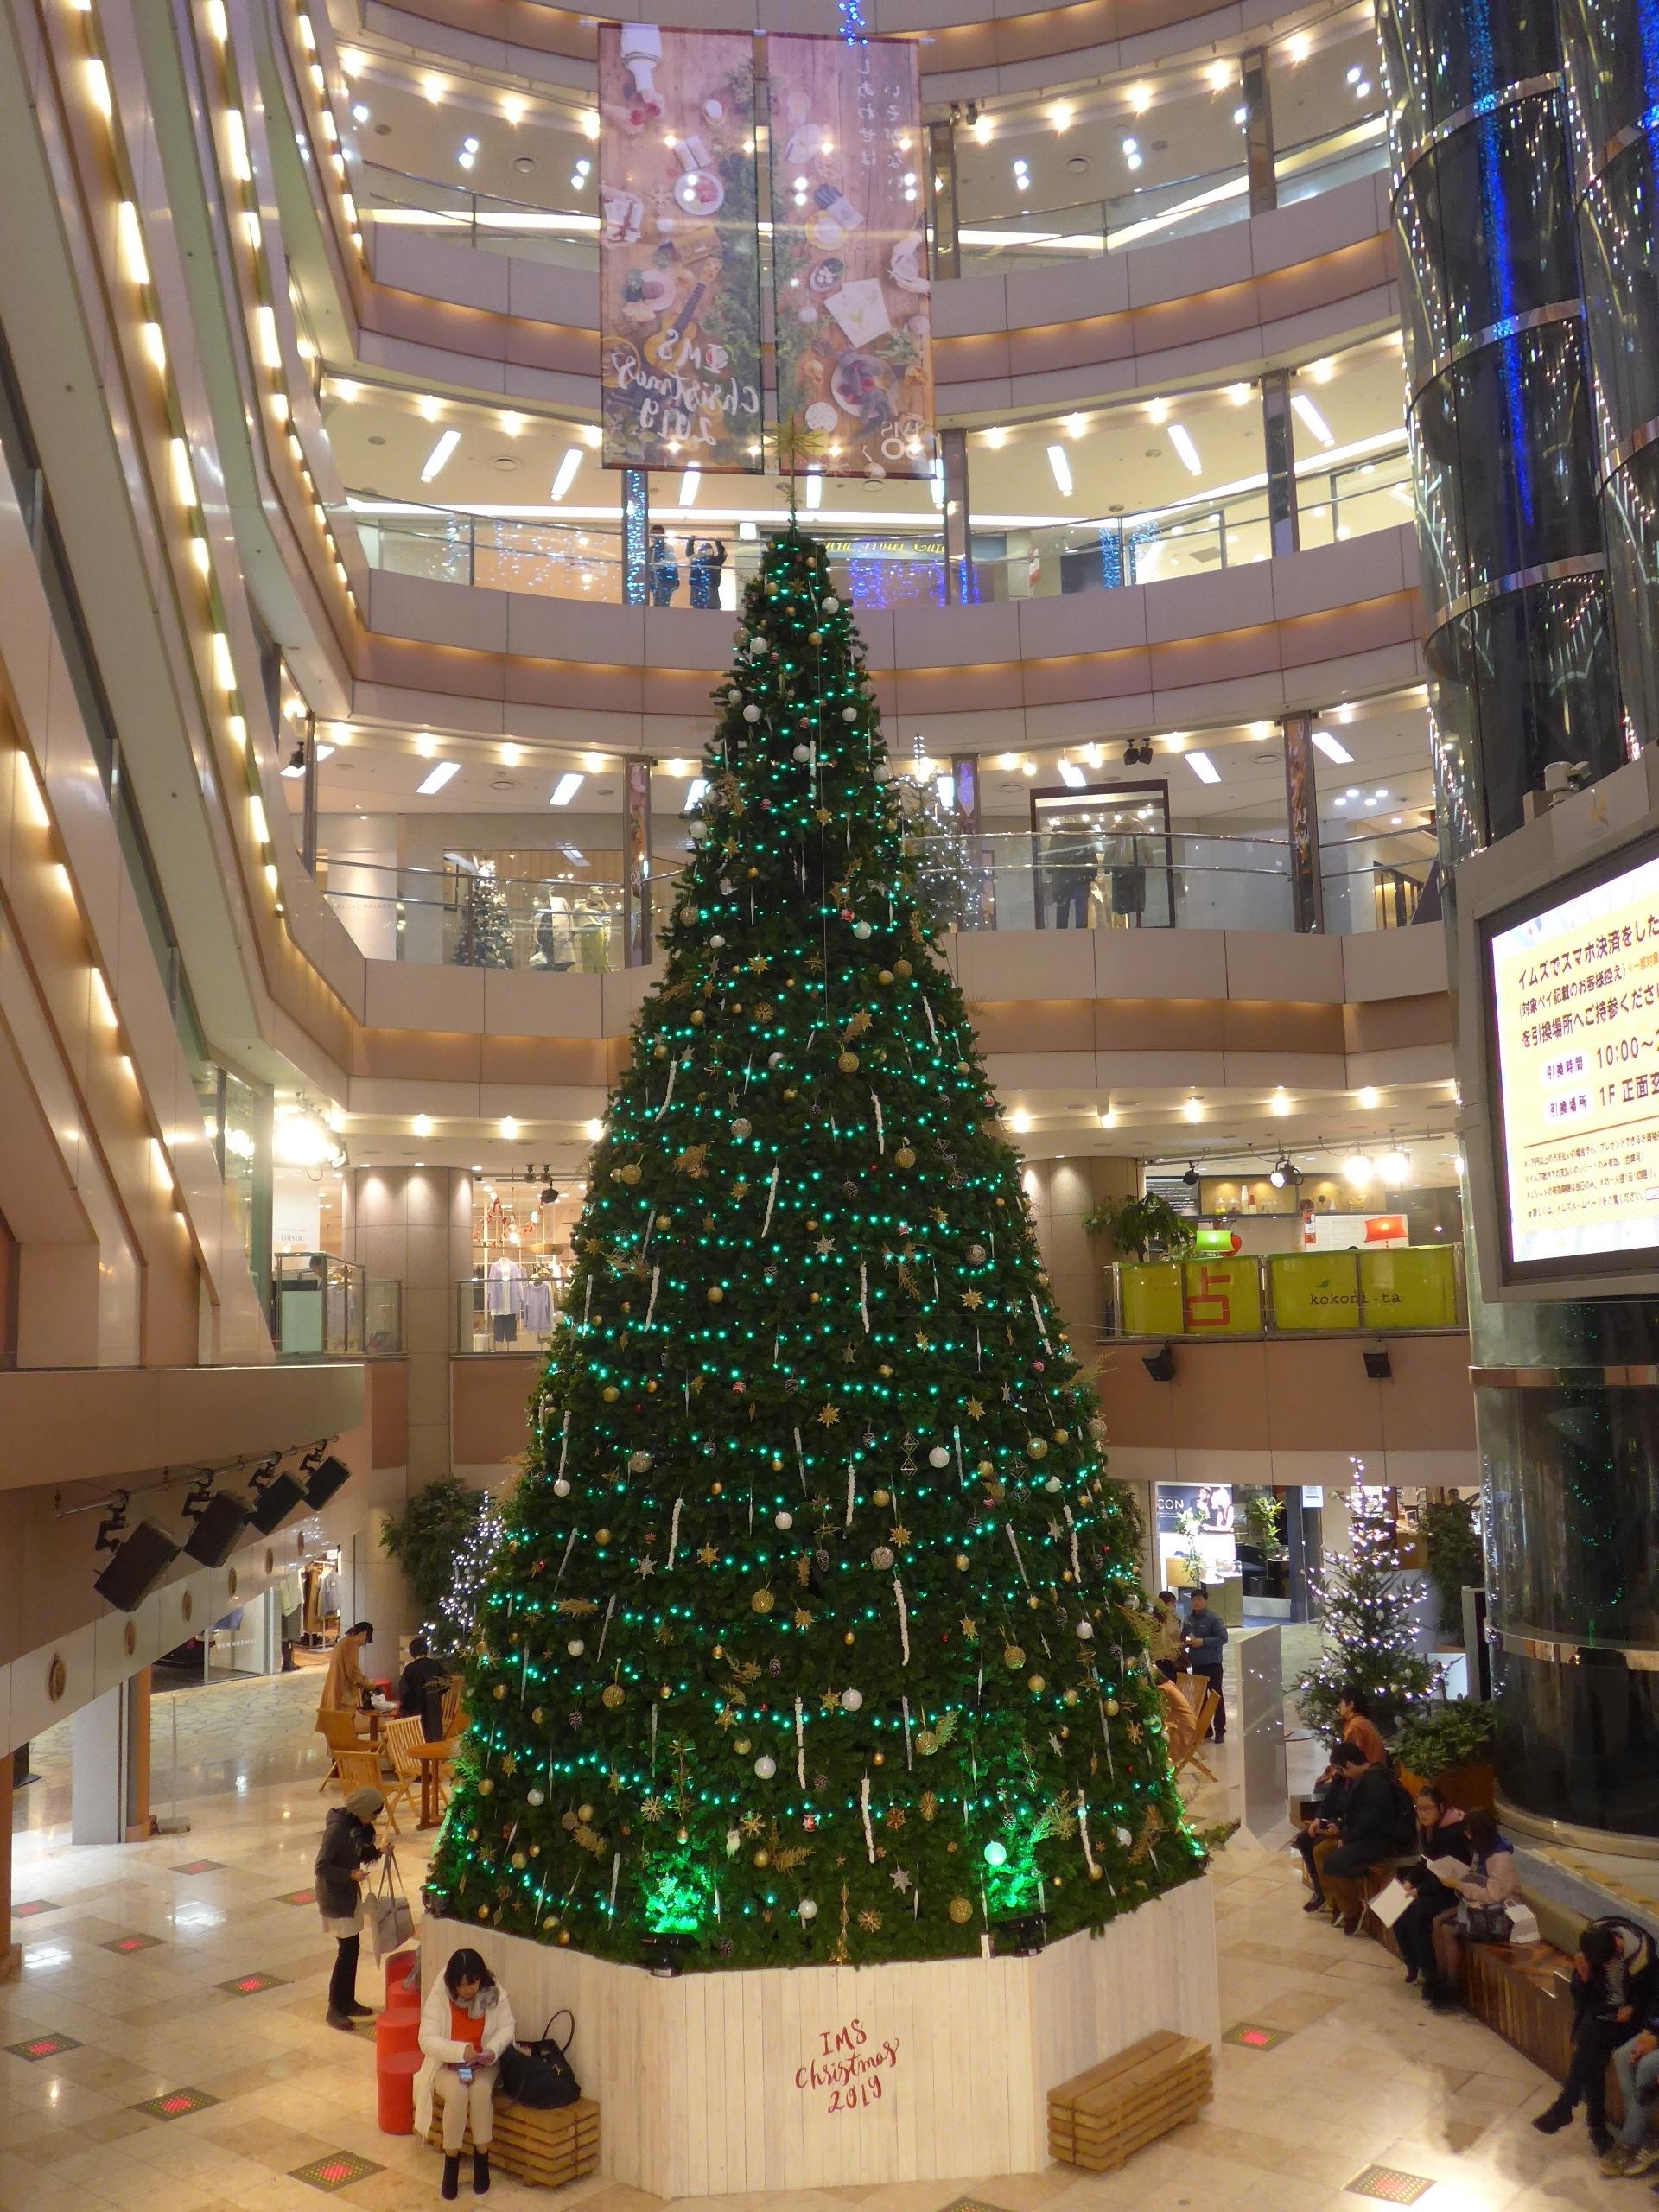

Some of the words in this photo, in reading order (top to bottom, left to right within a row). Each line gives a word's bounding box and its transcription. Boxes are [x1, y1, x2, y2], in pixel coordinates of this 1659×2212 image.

[1522, 982, 1659, 1048] を引換場所へご持参くださ
[820, 2018, 868, 2056] IMS
[795, 2037, 900, 2090] Christmas
[827, 2075, 882, 2113] 2019
